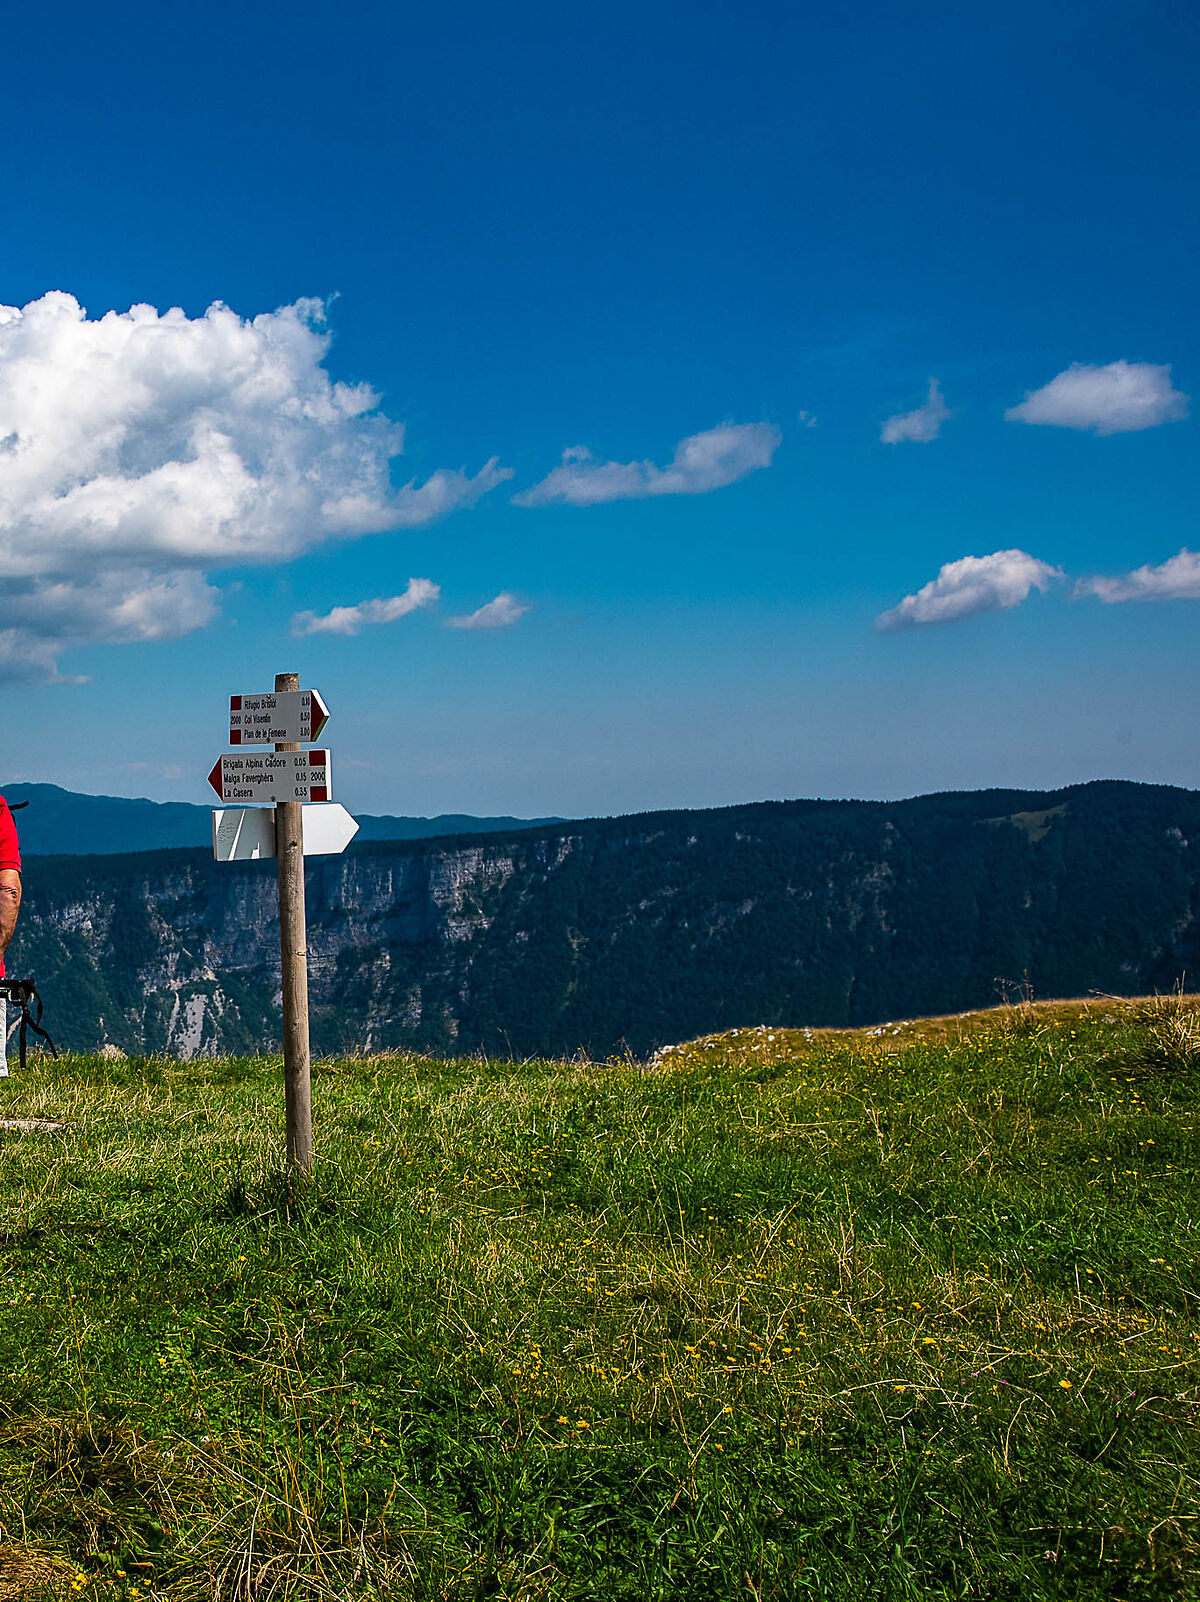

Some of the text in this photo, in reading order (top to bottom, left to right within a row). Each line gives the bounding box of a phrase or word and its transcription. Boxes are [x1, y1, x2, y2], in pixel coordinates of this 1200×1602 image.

[254, 729, 262, 738] de
[245, 759, 264, 769] Alpina
[265, 758, 286, 767] Cadore
[294, 757, 306, 766] 0.05
[224, 774, 240, 784] Malga
[311, 771, 325, 781] 2000
[224, 788, 231, 797] La
[295, 787, 307, 796] 0.35
